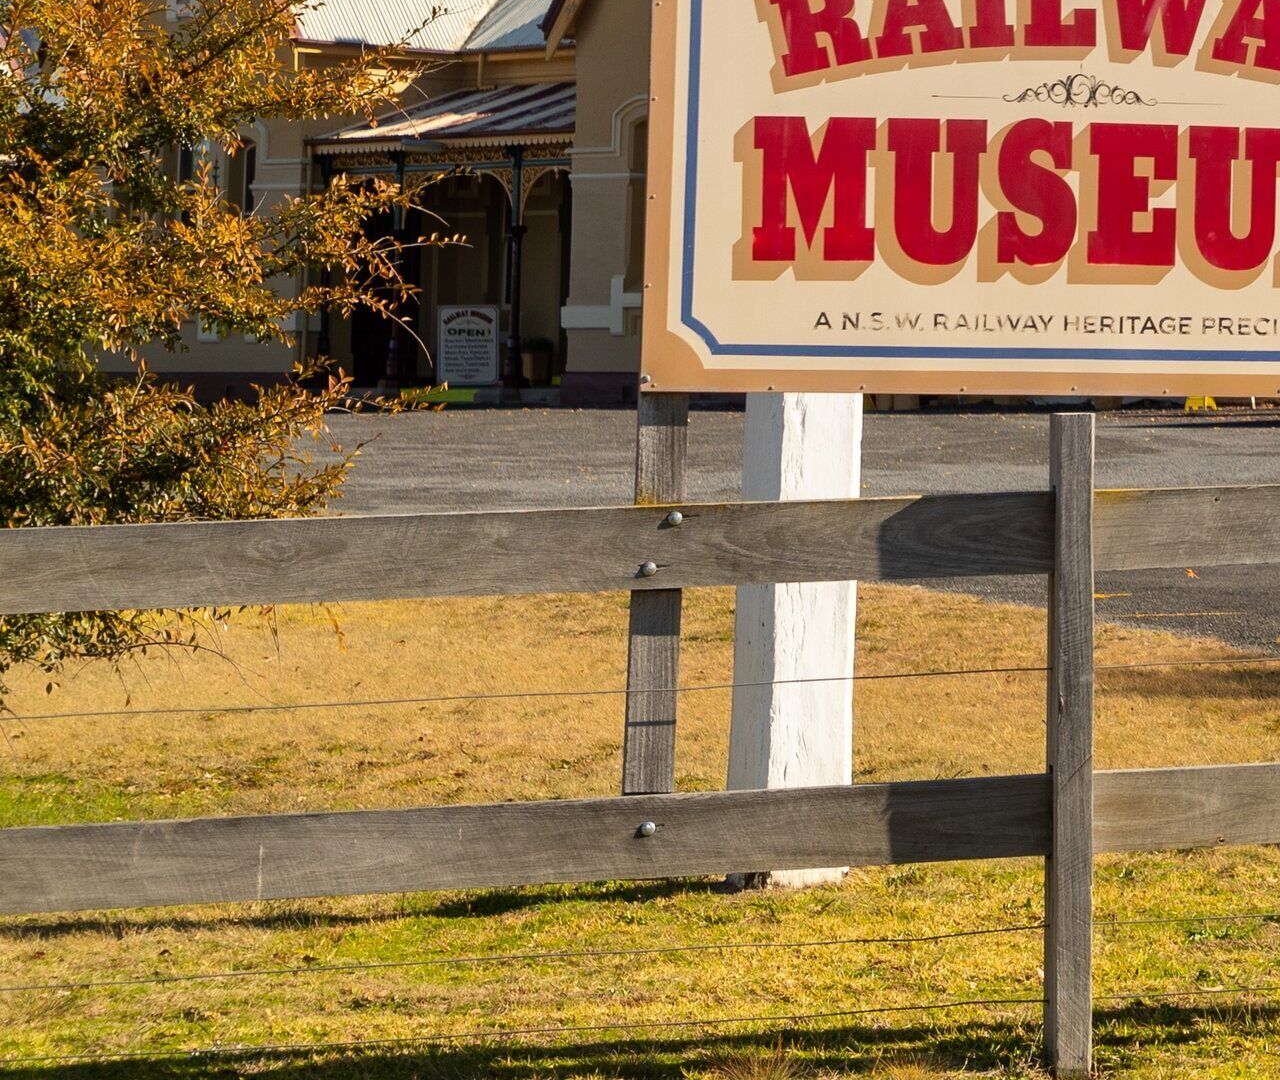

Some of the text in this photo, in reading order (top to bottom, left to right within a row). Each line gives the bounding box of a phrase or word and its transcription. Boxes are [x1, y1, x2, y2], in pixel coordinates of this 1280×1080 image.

[813, 311, 833, 330] A
[841, 311, 925, 332] N.S.W.
[933, 312, 1054, 333] RAILWAY
[1063, 314, 1193, 335] HERITAGE
